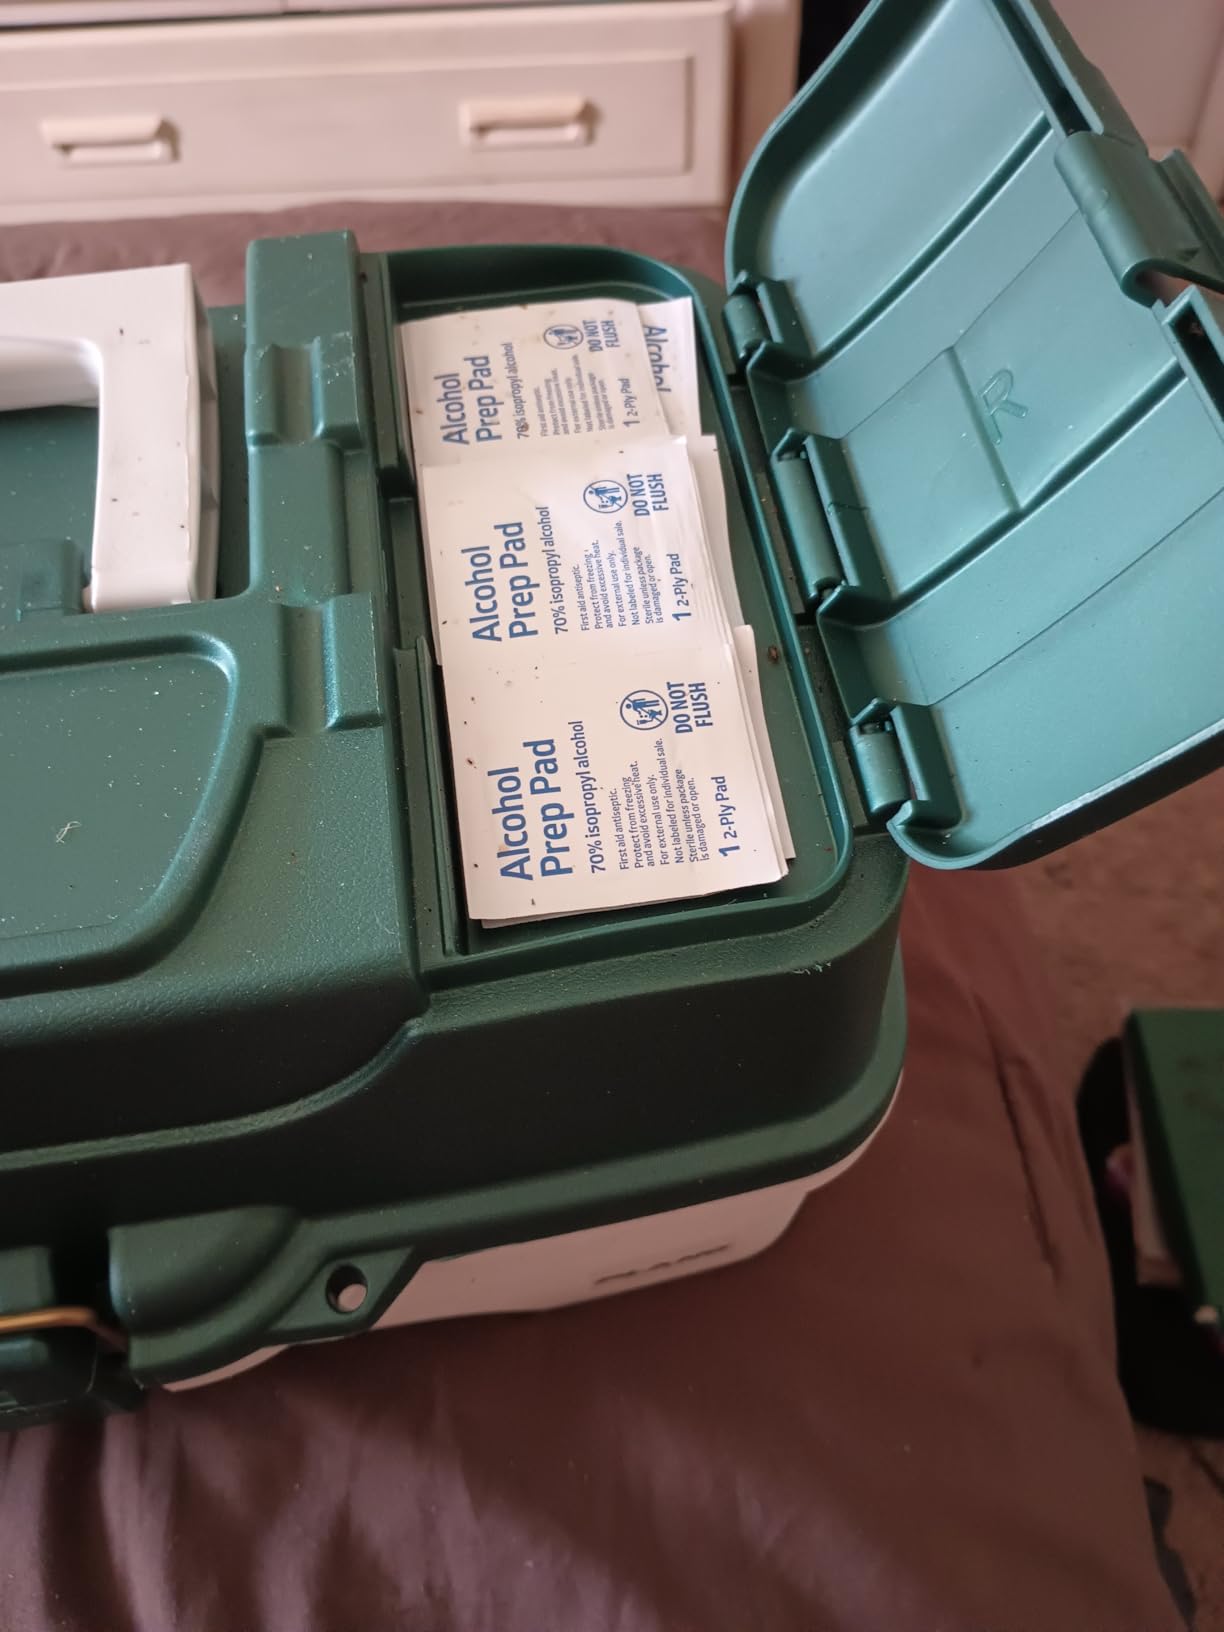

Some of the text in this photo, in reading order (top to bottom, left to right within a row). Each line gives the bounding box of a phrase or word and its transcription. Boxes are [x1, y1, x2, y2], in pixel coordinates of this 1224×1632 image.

[501, 342, 518, 374] alcohol
[582, 320, 603, 352] DO NOT
[601, 320, 619, 347] FLUSH
[434, 373, 469, 444] Alcohol
[464, 356, 504, 442] Prep Pad
[506, 375, 526, 416] isopropyl
[618, 378, 632, 393] Pad
[624, 395, 638, 416] 2-Ply
[980, 368, 1029, 445] R
[626, 474, 650, 516] DO NOT
[646, 474, 668, 511] FLUSH
[461, 546, 501, 641] Alcohol
[494, 522, 540, 638] Prep Pad
[535, 506, 568, 634] 70% isopropyl alcohol
[666, 553, 691, 621] 1 2-Ply Pad
[666, 682, 693, 733] DO NOT
[688, 682, 713, 727] FLUSH
[487, 767, 532, 880] Alcohol
[523, 739, 574, 876] Prep Pad
[568, 721, 605, 873] 70% isopropyl alcohol
[609, 789, 629, 869] First aid antiseptic.
[622, 777, 643, 868] Protect from freezing
[630, 761, 654, 866] and avoid excessive heat.
[646, 774, 669, 865] For external use only.
[654, 738, 684, 863] Not labeled for individual sale.
[675, 769, 698, 862] Sterile unless package
[687, 778, 709, 861] is damaged or open.
[711, 776, 740, 856] 1 2-Ply Pad
